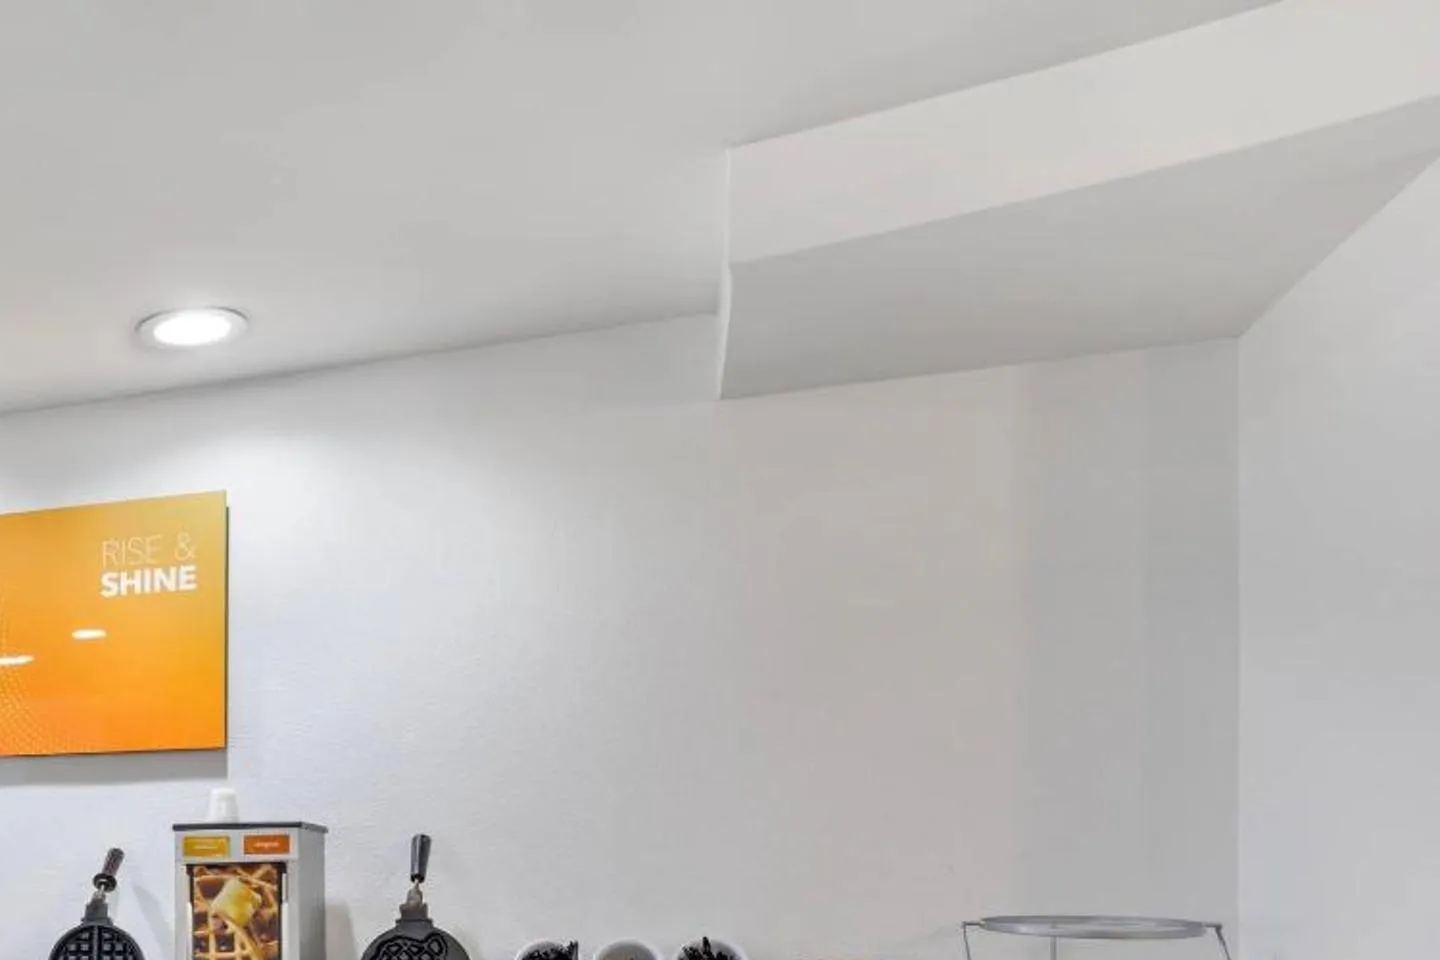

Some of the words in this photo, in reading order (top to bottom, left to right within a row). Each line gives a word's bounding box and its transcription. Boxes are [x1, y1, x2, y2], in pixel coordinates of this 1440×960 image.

[102, 534, 163, 567] RISE
[174, 532, 198, 561] &
[100, 565, 197, 597] SHINE
